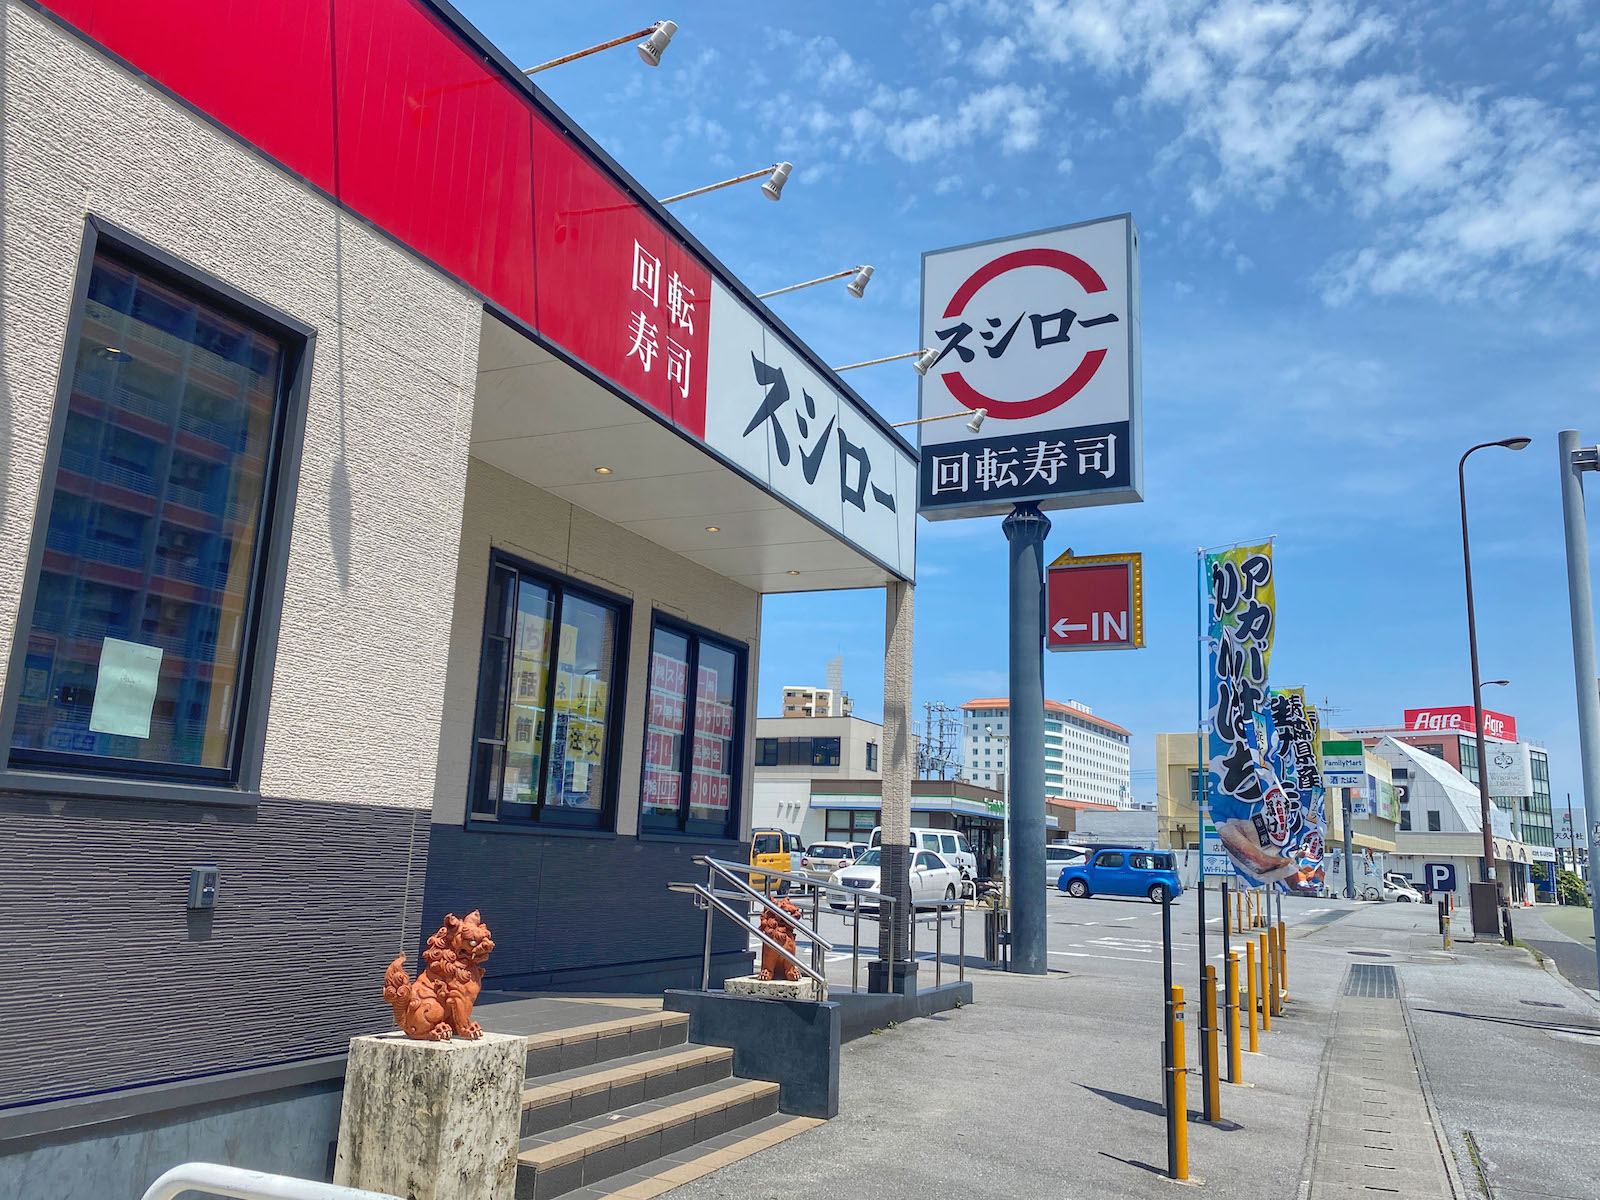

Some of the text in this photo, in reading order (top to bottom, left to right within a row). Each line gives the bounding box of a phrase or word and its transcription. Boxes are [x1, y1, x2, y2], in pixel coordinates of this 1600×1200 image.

[631, 238, 695, 336] 回転
[627, 310, 692, 399] 寿司
[930, 308, 1119, 369] スシロー
[743, 350, 896, 514] スシロー
[931, 433, 1117, 496] 回転寿司
[1092, 610, 1127, 642] IN
[1413, 712, 1462, 731] Agre
[1484, 714, 1504, 736] Agre
[568, 727, 601, 758] 注文
[1324, 759, 1362, 767] FamilyMart
[1431, 865, 1450, 890] P
